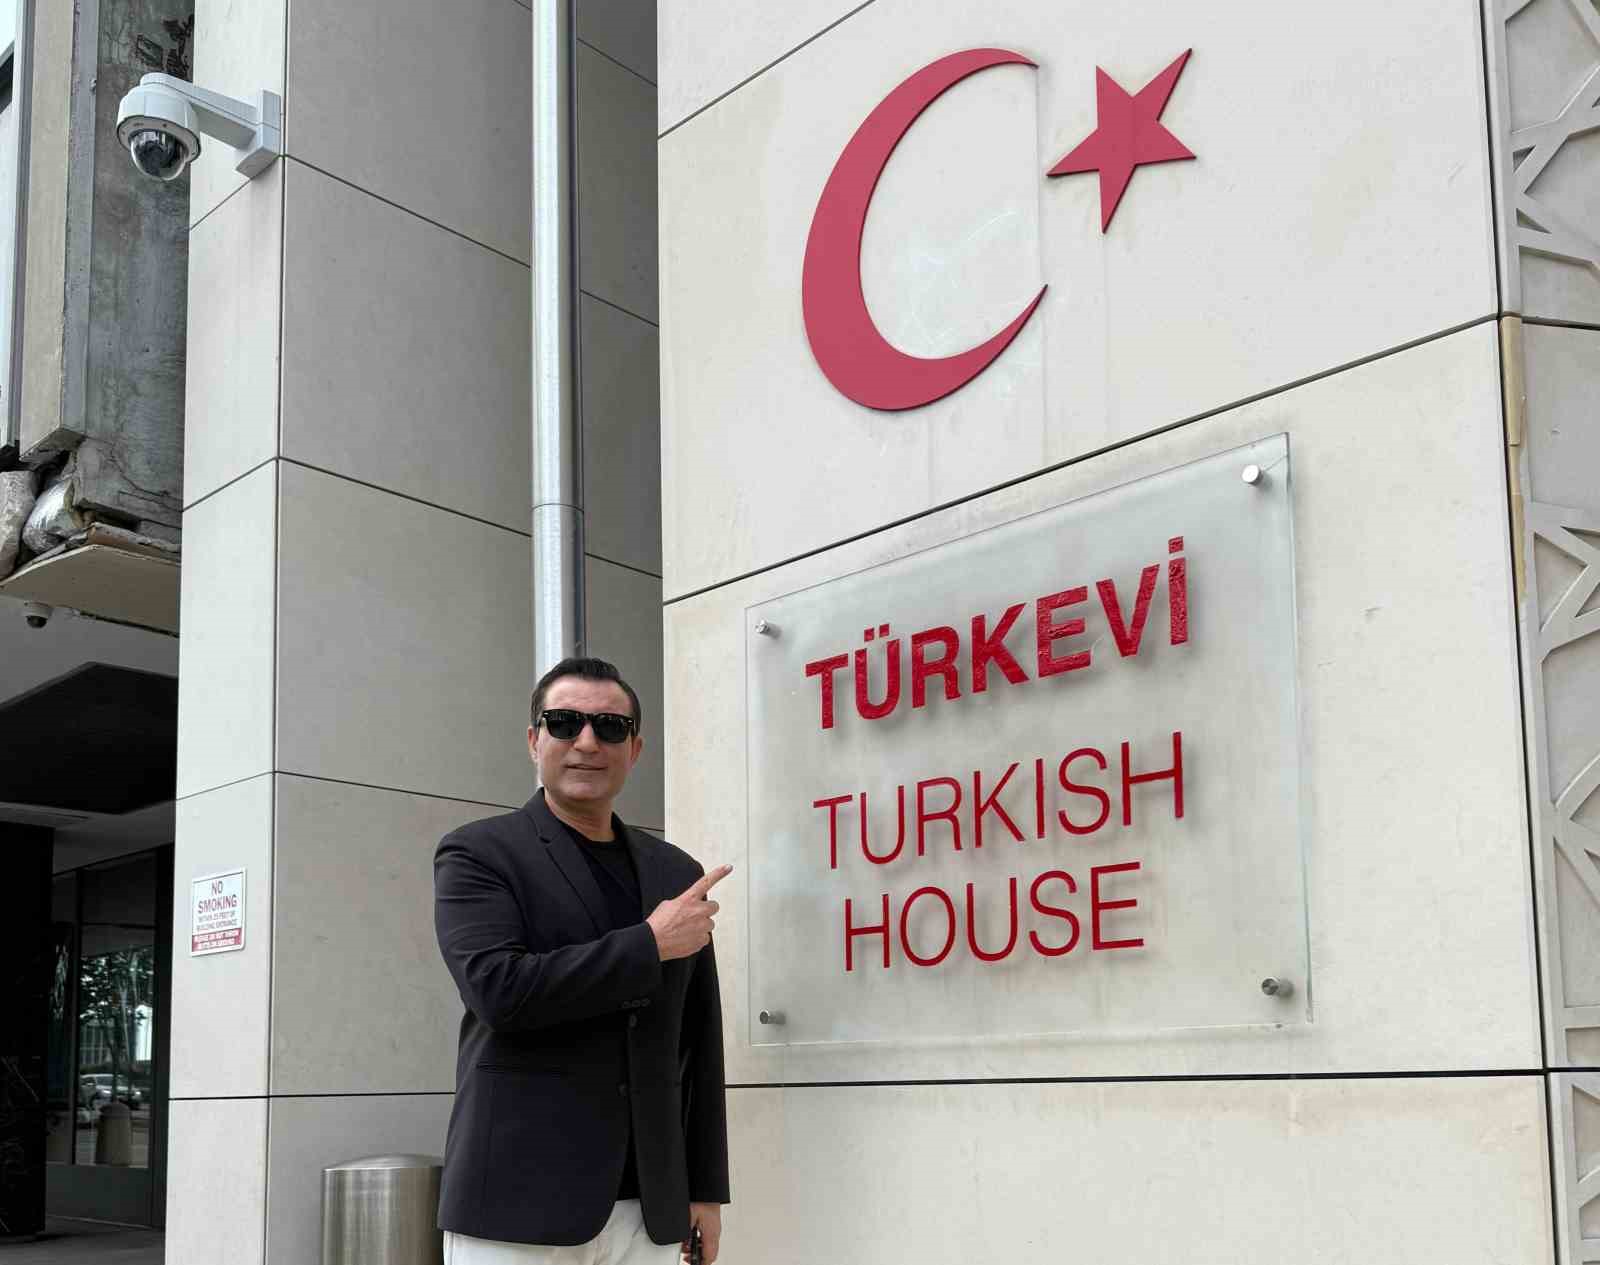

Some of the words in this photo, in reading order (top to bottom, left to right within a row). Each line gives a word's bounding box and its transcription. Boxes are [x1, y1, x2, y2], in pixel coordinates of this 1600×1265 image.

[803, 536, 1189, 731] TÜRKEVİ
[812, 731, 1185, 870] TURKISH
[198, 894, 237, 914] SMOKING
[211, 880, 223, 895] NO
[843, 861, 1145, 972] HOUSE
